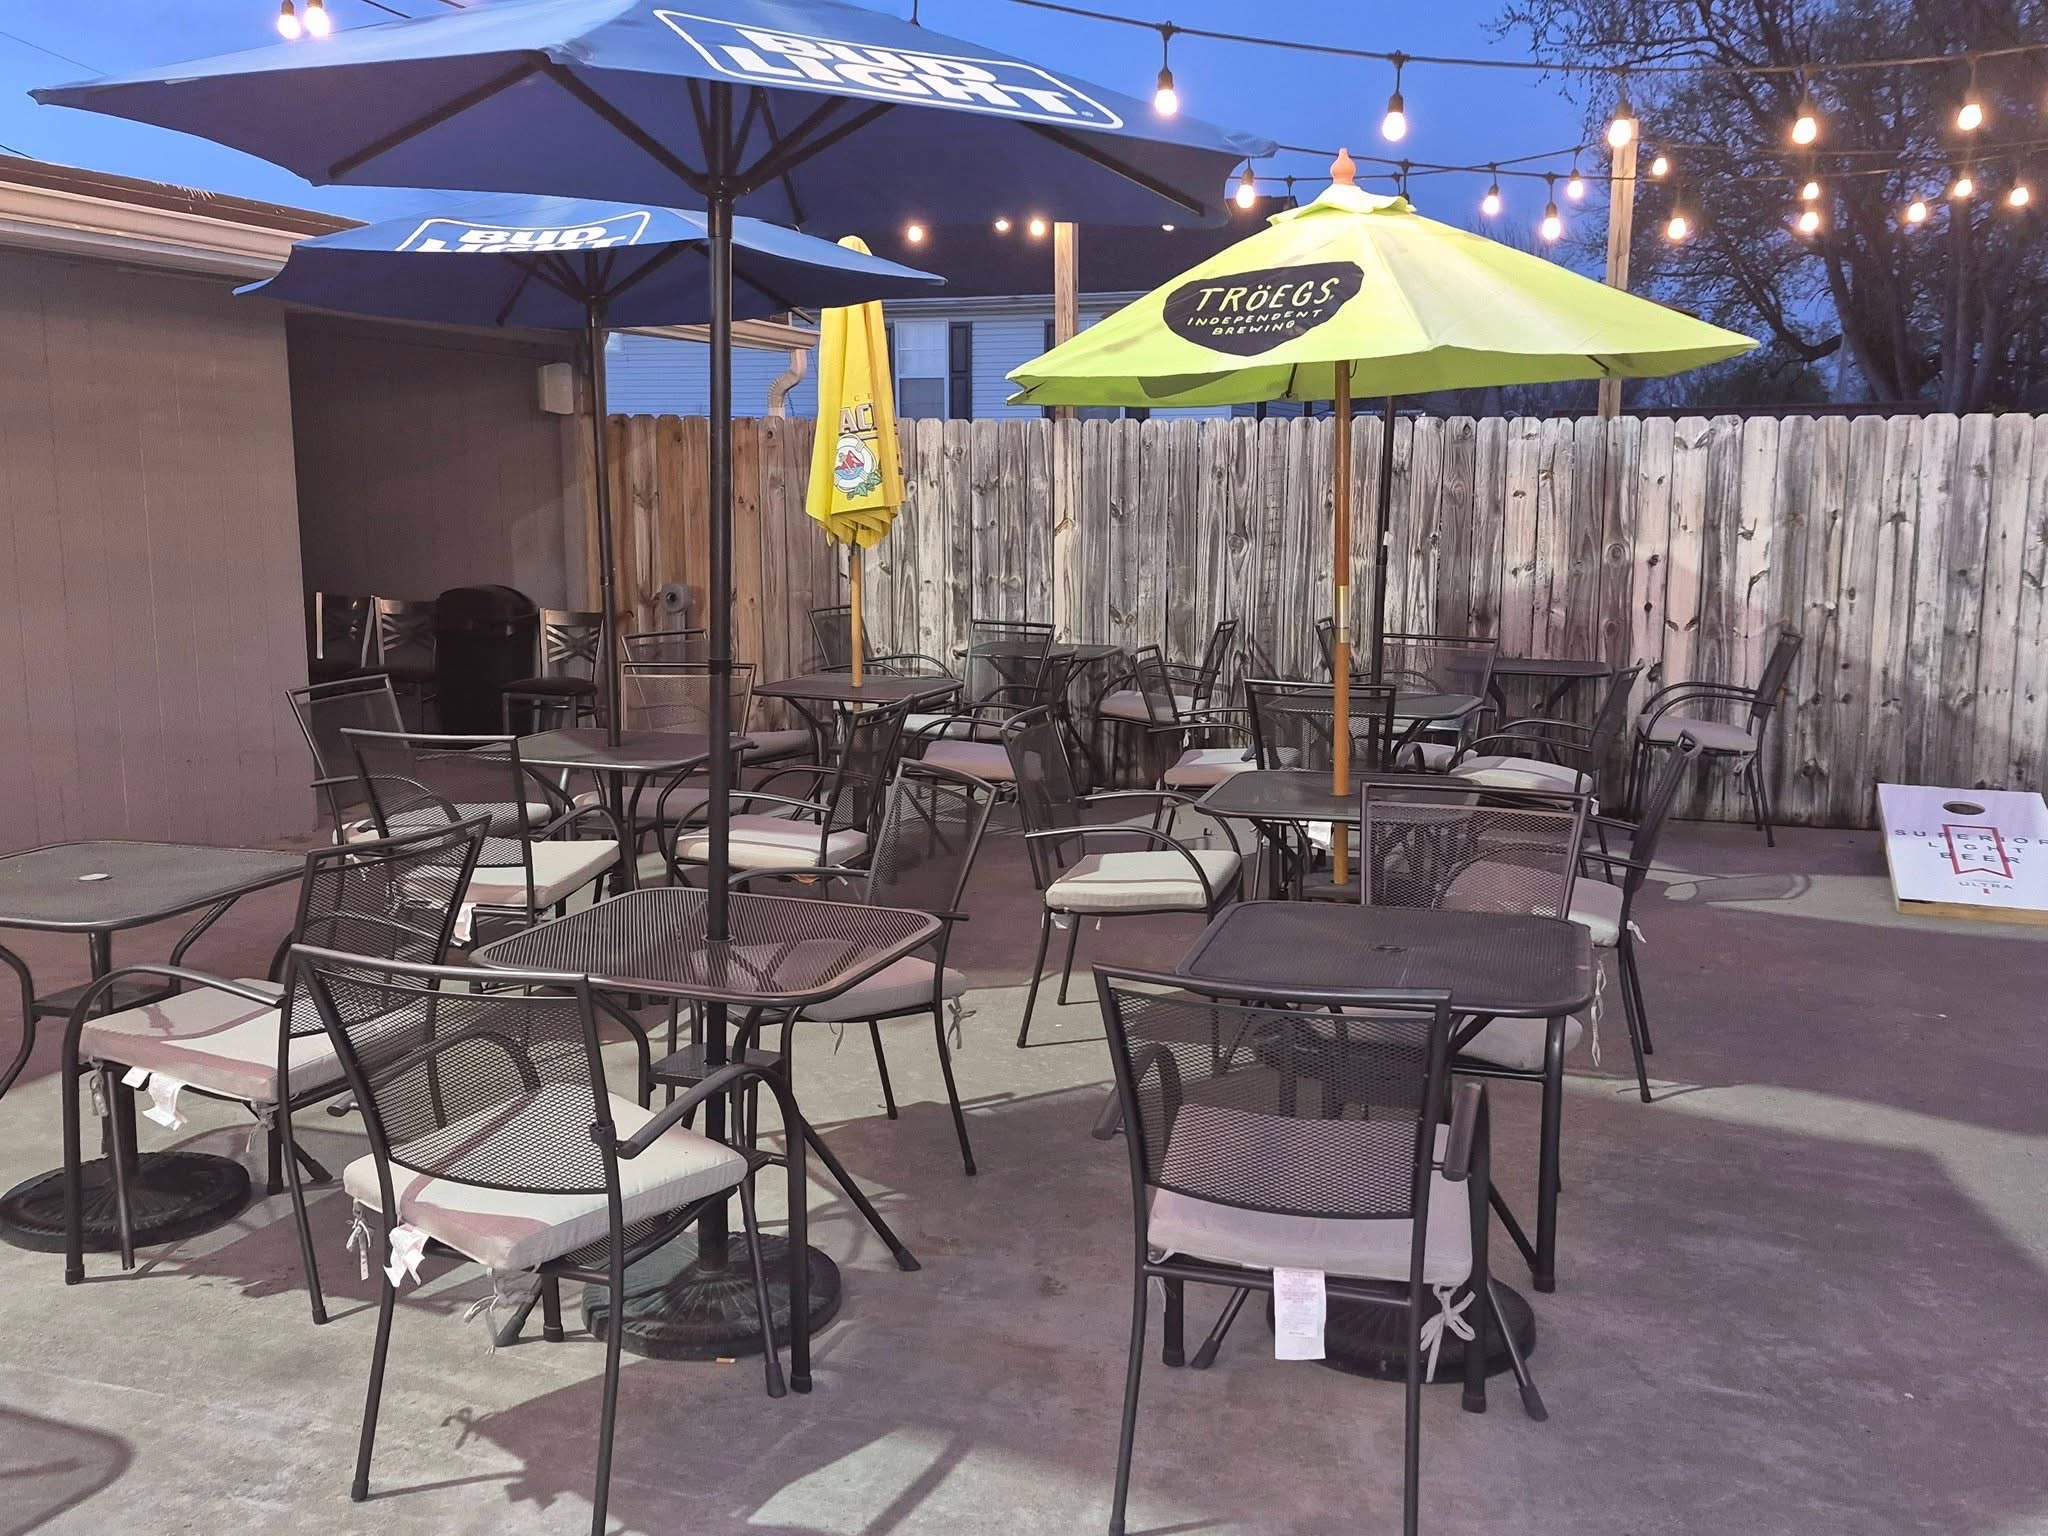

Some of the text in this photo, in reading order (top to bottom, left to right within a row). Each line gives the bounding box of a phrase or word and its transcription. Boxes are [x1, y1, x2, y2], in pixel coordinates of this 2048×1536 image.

[735, 28, 997, 84] BUD
[719, 45, 1078, 115] LIGHT
[458, 226, 608, 244] BUD
[1196, 277, 1340, 312] TRÖEGS
[1187, 308, 1323, 326] INDEPENDENT
[1211, 320, 1296, 336] BREWING
